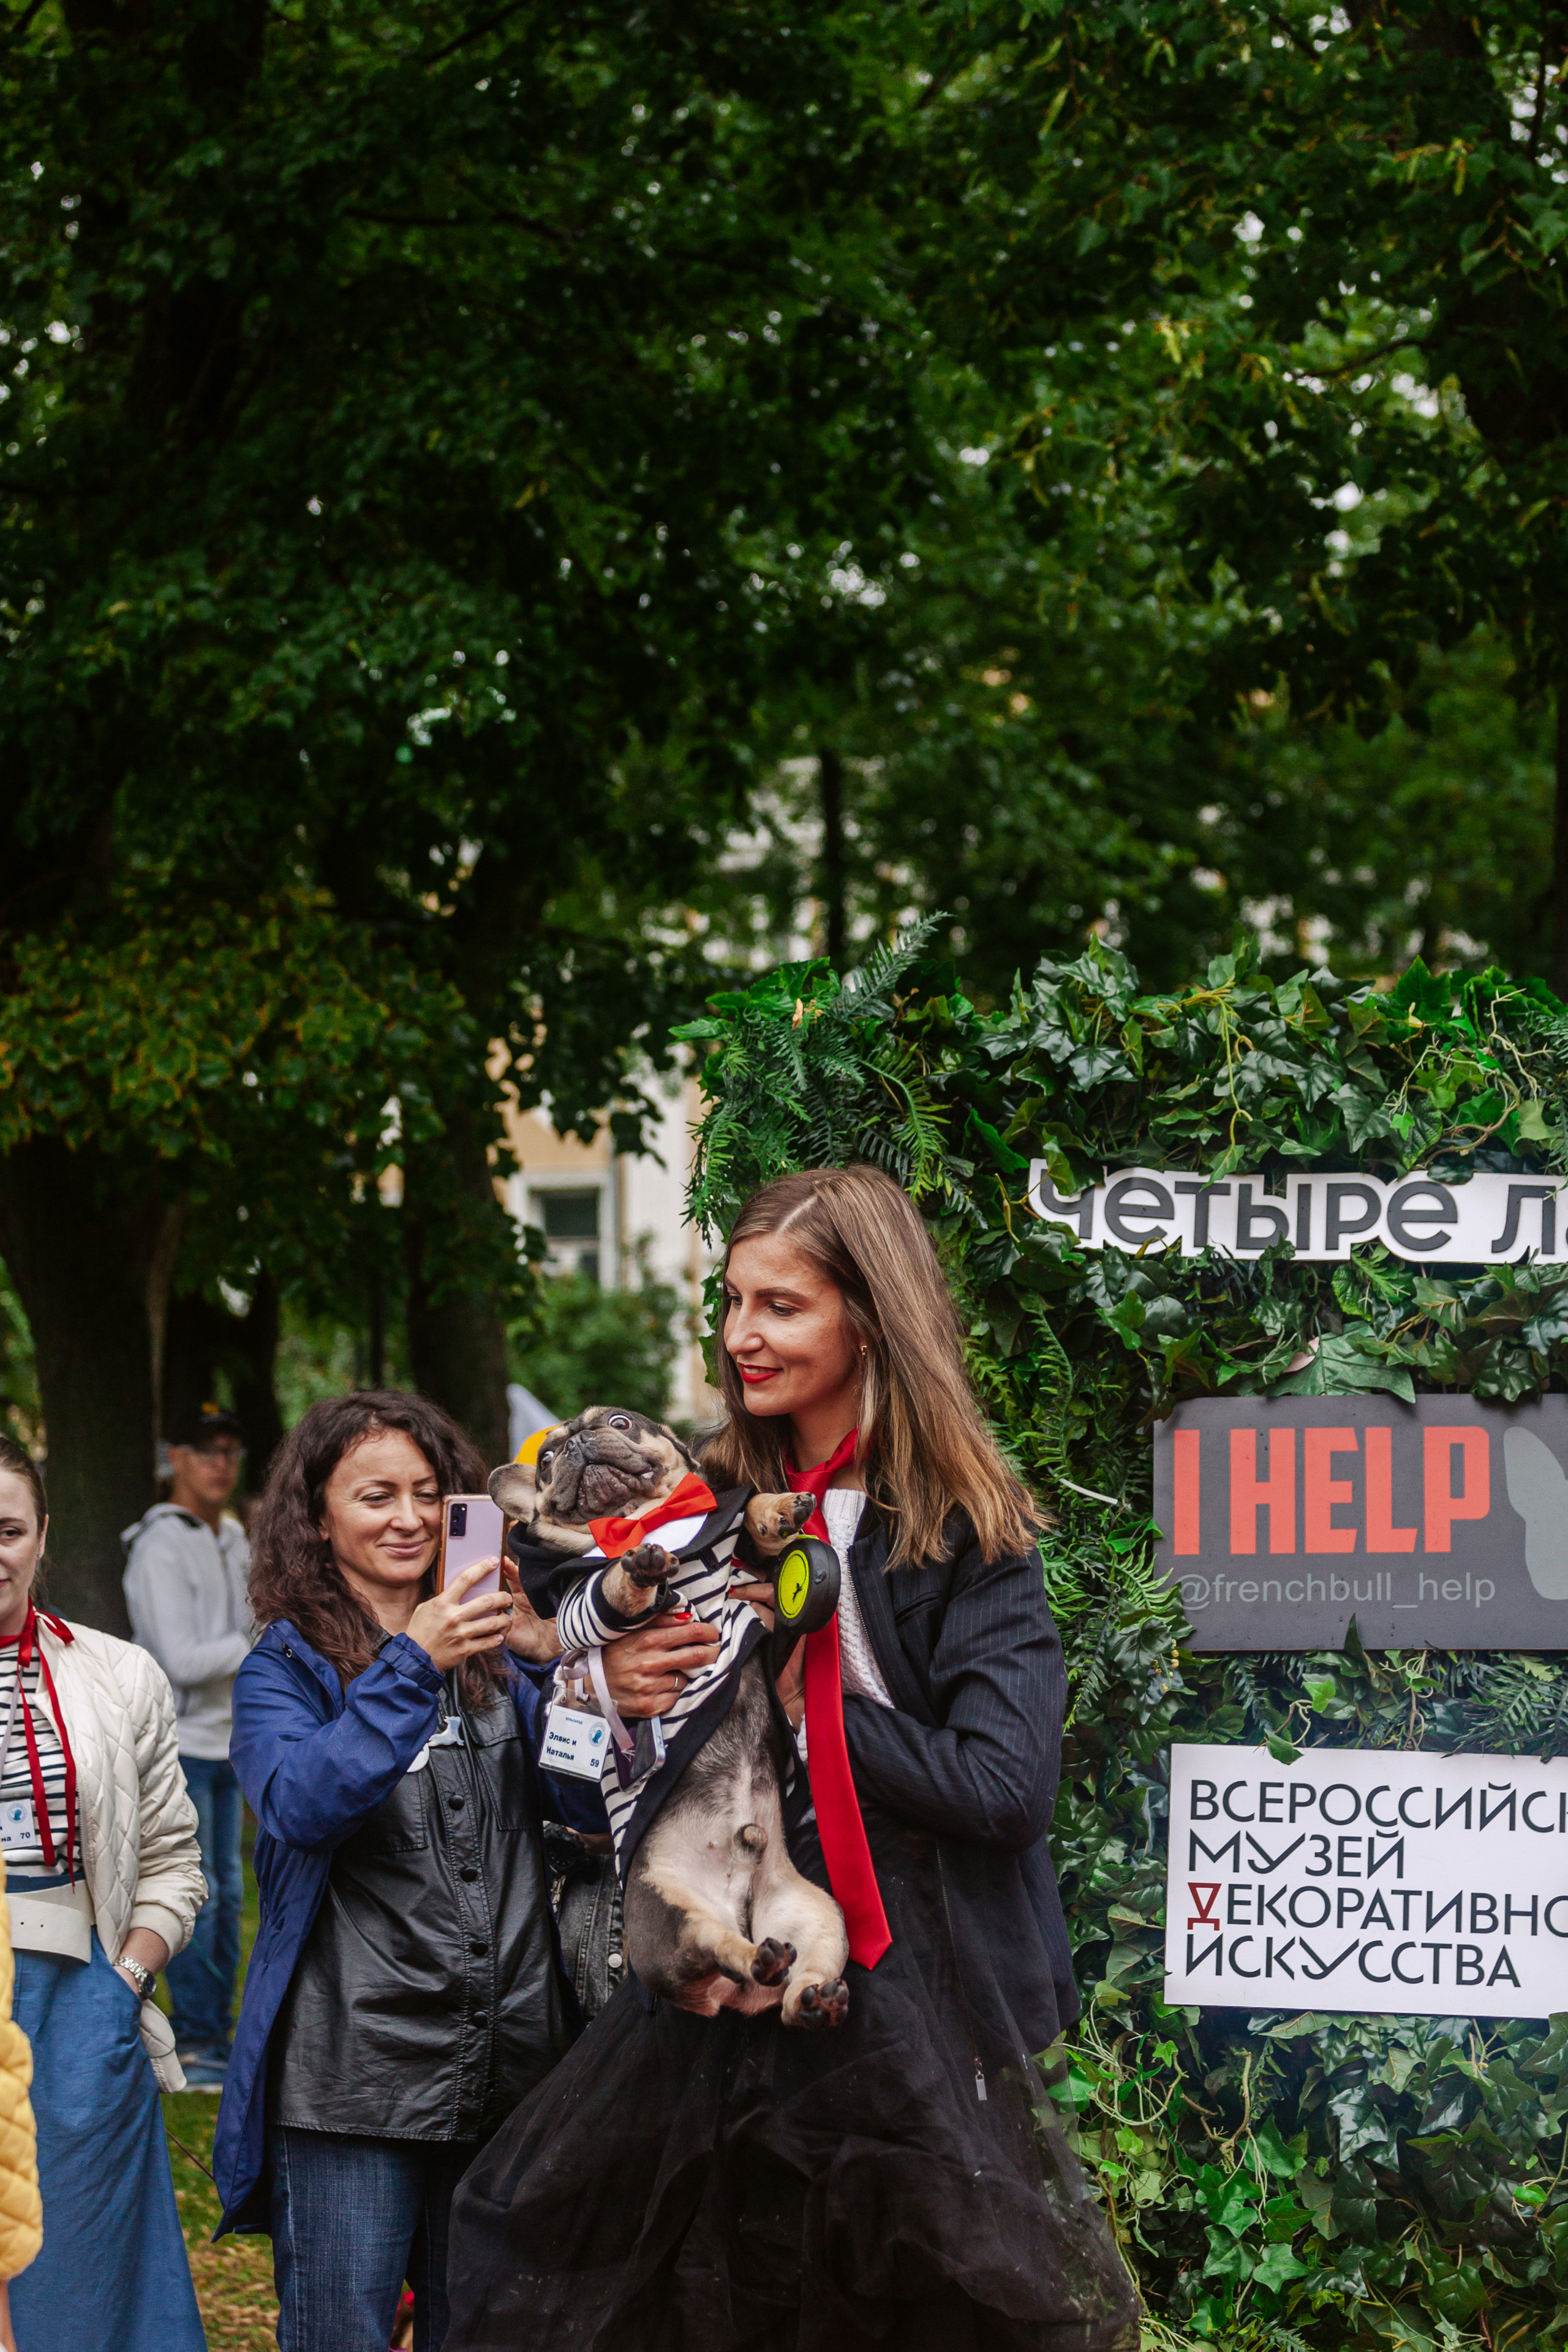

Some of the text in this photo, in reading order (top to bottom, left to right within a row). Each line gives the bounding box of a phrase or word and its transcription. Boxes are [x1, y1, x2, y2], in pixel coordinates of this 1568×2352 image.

[1174, 1425, 1490, 1555] I HELP
[1175, 1572, 1496, 1611] @frenchbull_help
[546, 1746, 575, 1761] Наталья
[549, 1732, 570, 1744] Элвис
[590, 1758, 600, 1768] 59
[1188, 1828, 1405, 1879] МУЗЕЙ
[1187, 1882, 1568, 1938] ДЕКОРАТИВНО
[1186, 1933, 1522, 1988] ИСКУССТВА
